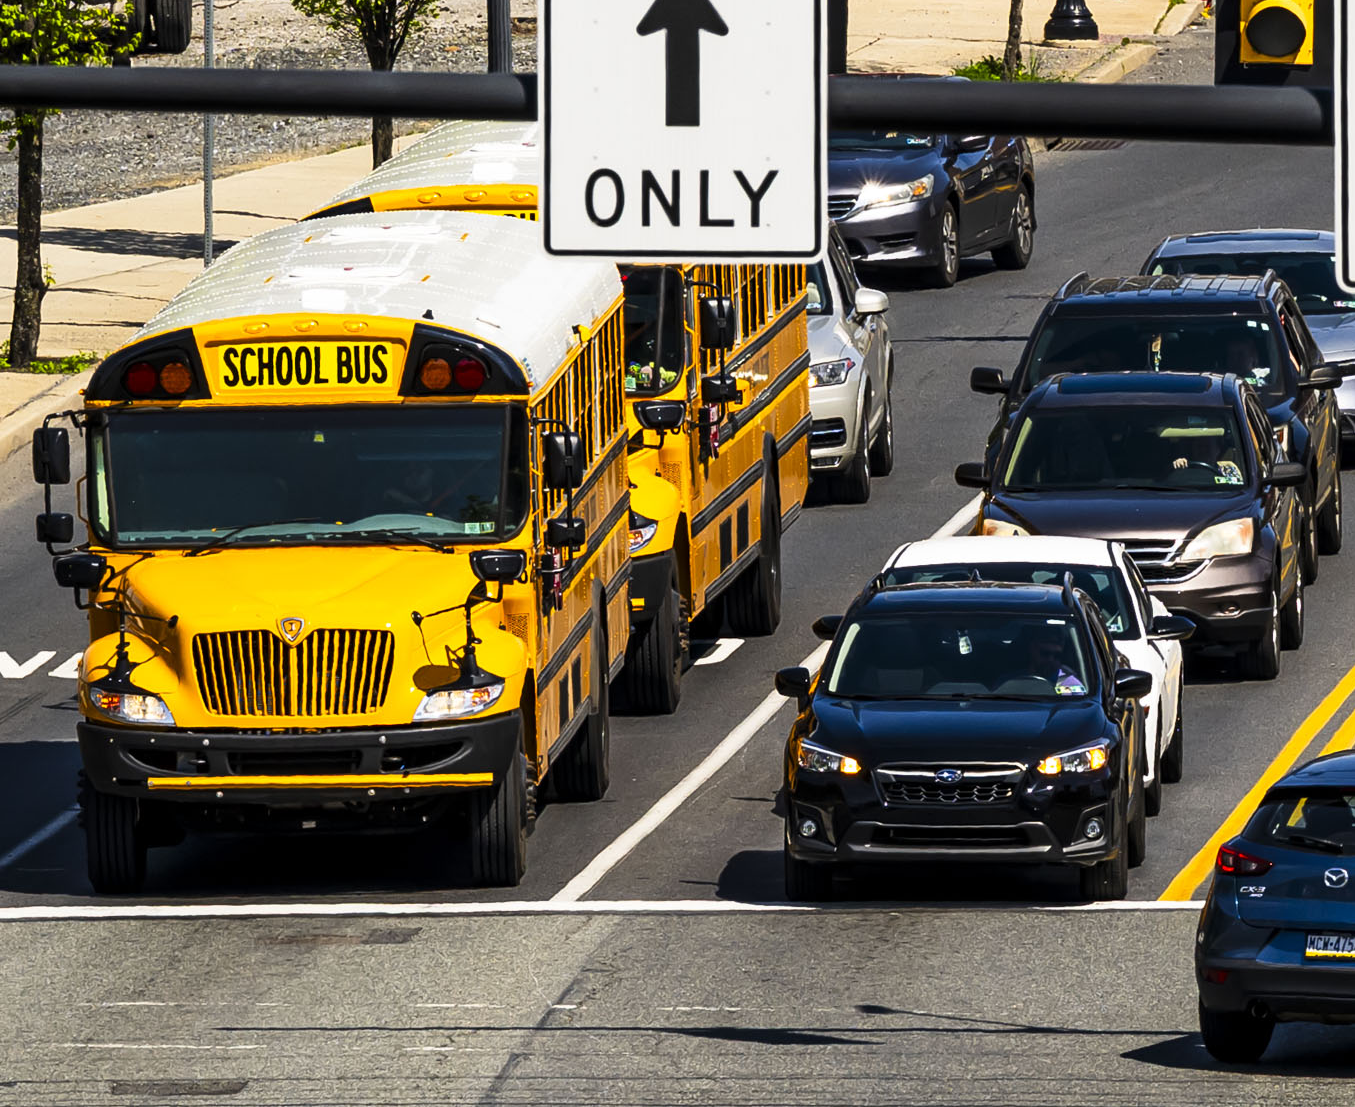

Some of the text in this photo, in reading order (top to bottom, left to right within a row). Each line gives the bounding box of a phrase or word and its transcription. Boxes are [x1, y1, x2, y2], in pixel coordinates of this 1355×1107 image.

[585, 168, 780, 228] ONLY
[223, 344, 388, 387] SCHOOL BUS
